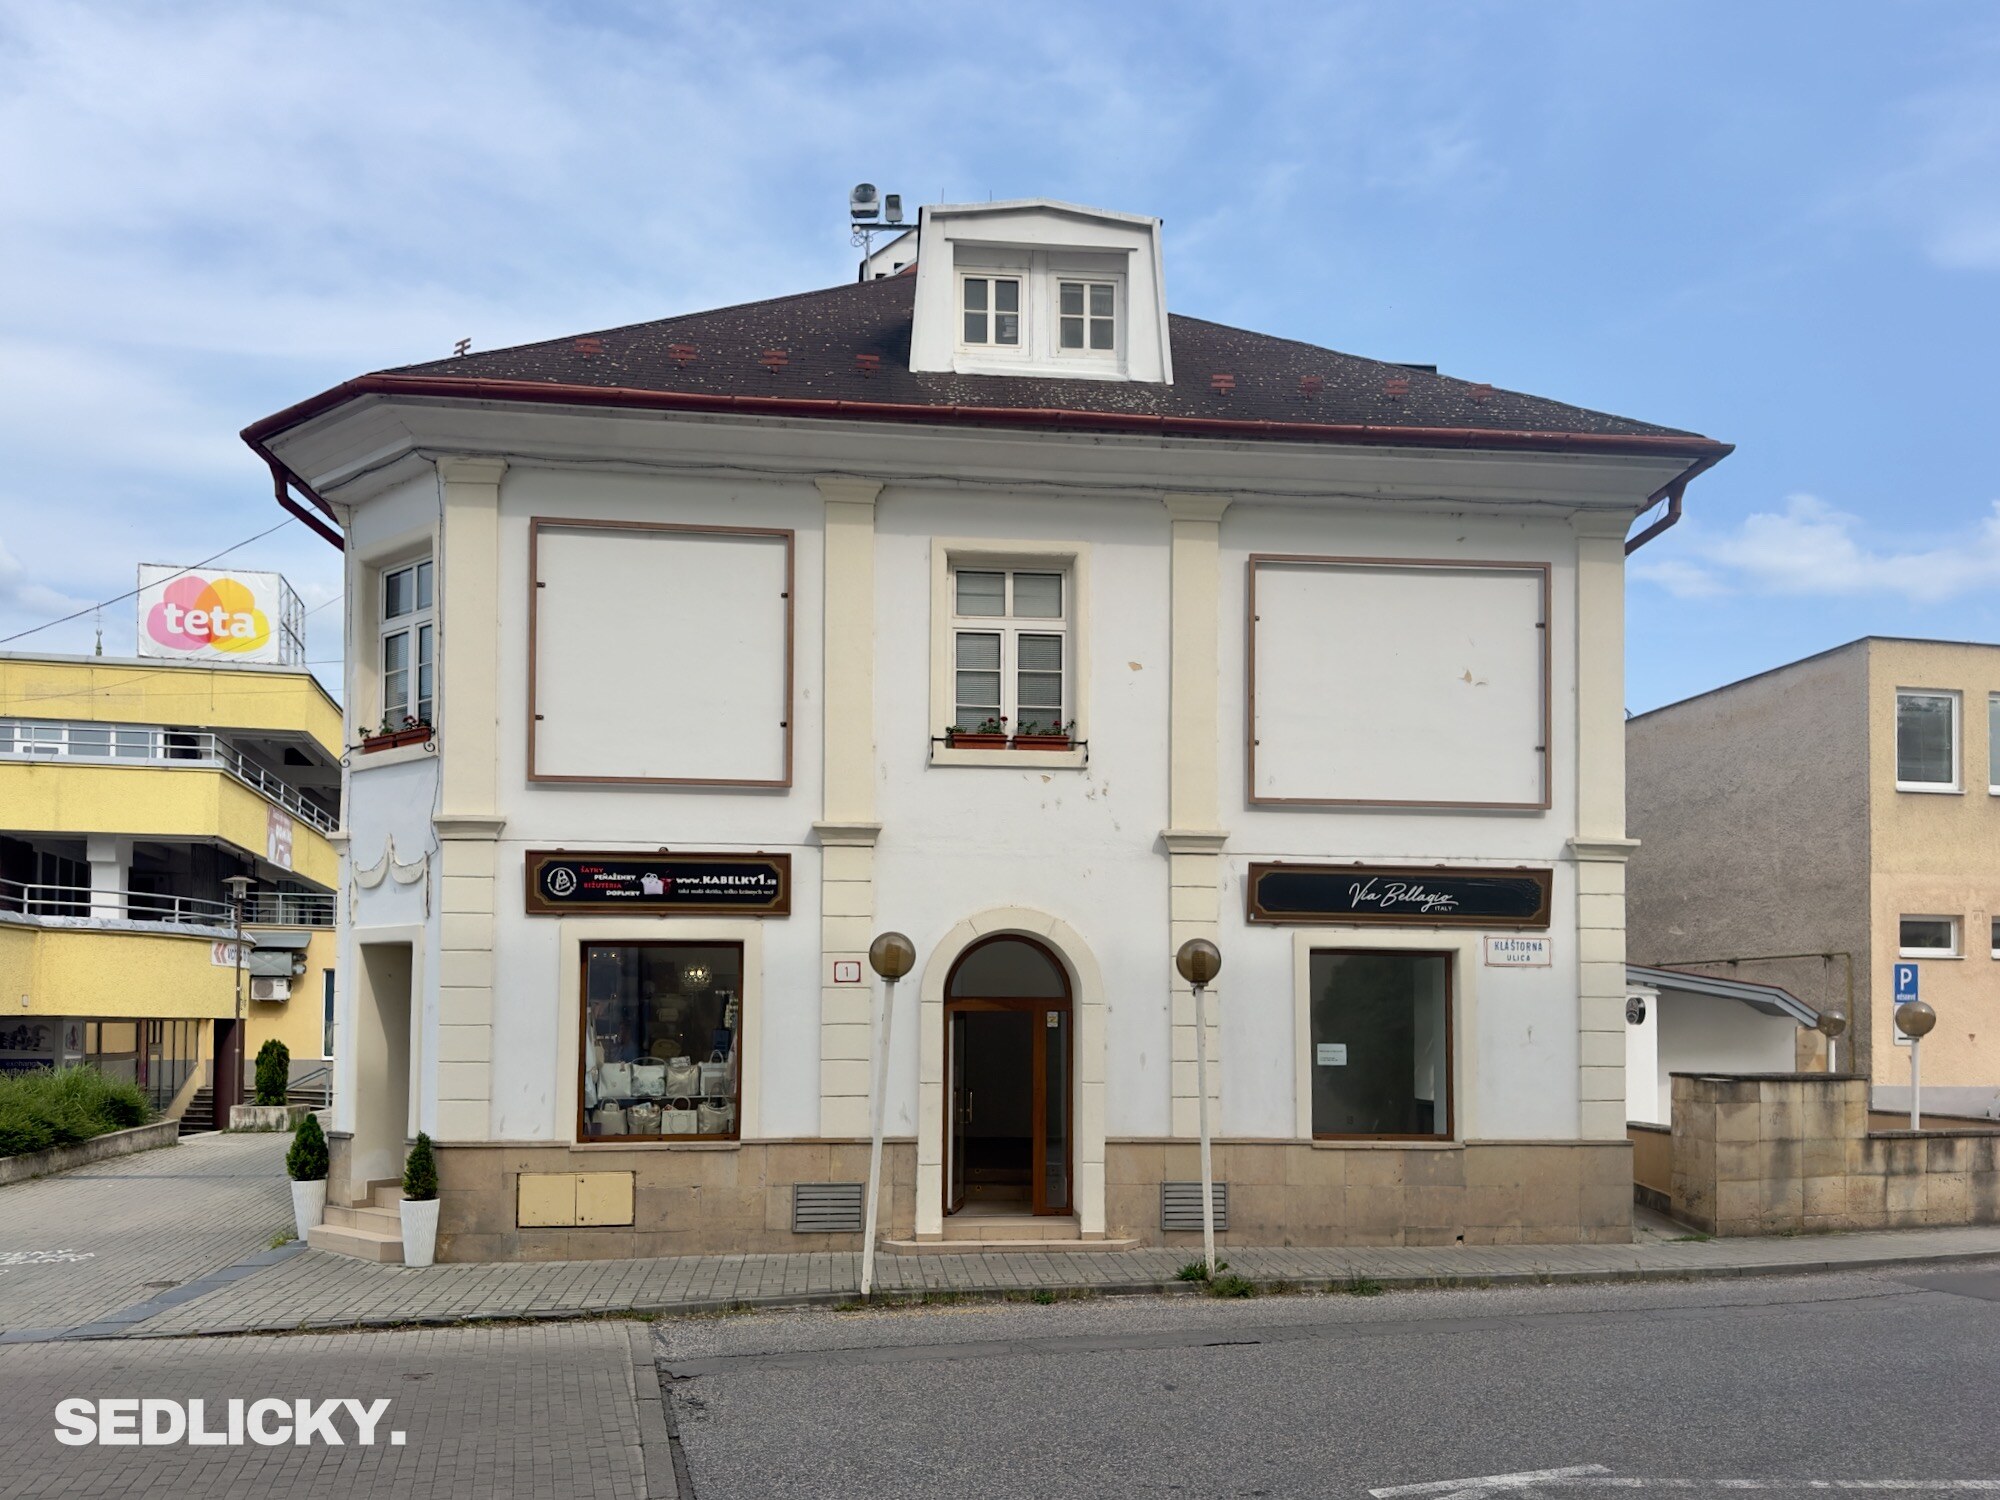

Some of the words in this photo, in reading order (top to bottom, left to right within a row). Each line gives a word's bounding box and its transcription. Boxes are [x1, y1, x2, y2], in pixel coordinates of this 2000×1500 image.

[164, 603, 255, 638] teta
[1349, 877, 1382, 908] Via
[1380, 883, 1459, 912] Bellagio
[1494, 939, 1543, 951] KLÁŠTORNÁ
[1901, 968, 1912, 990] P
